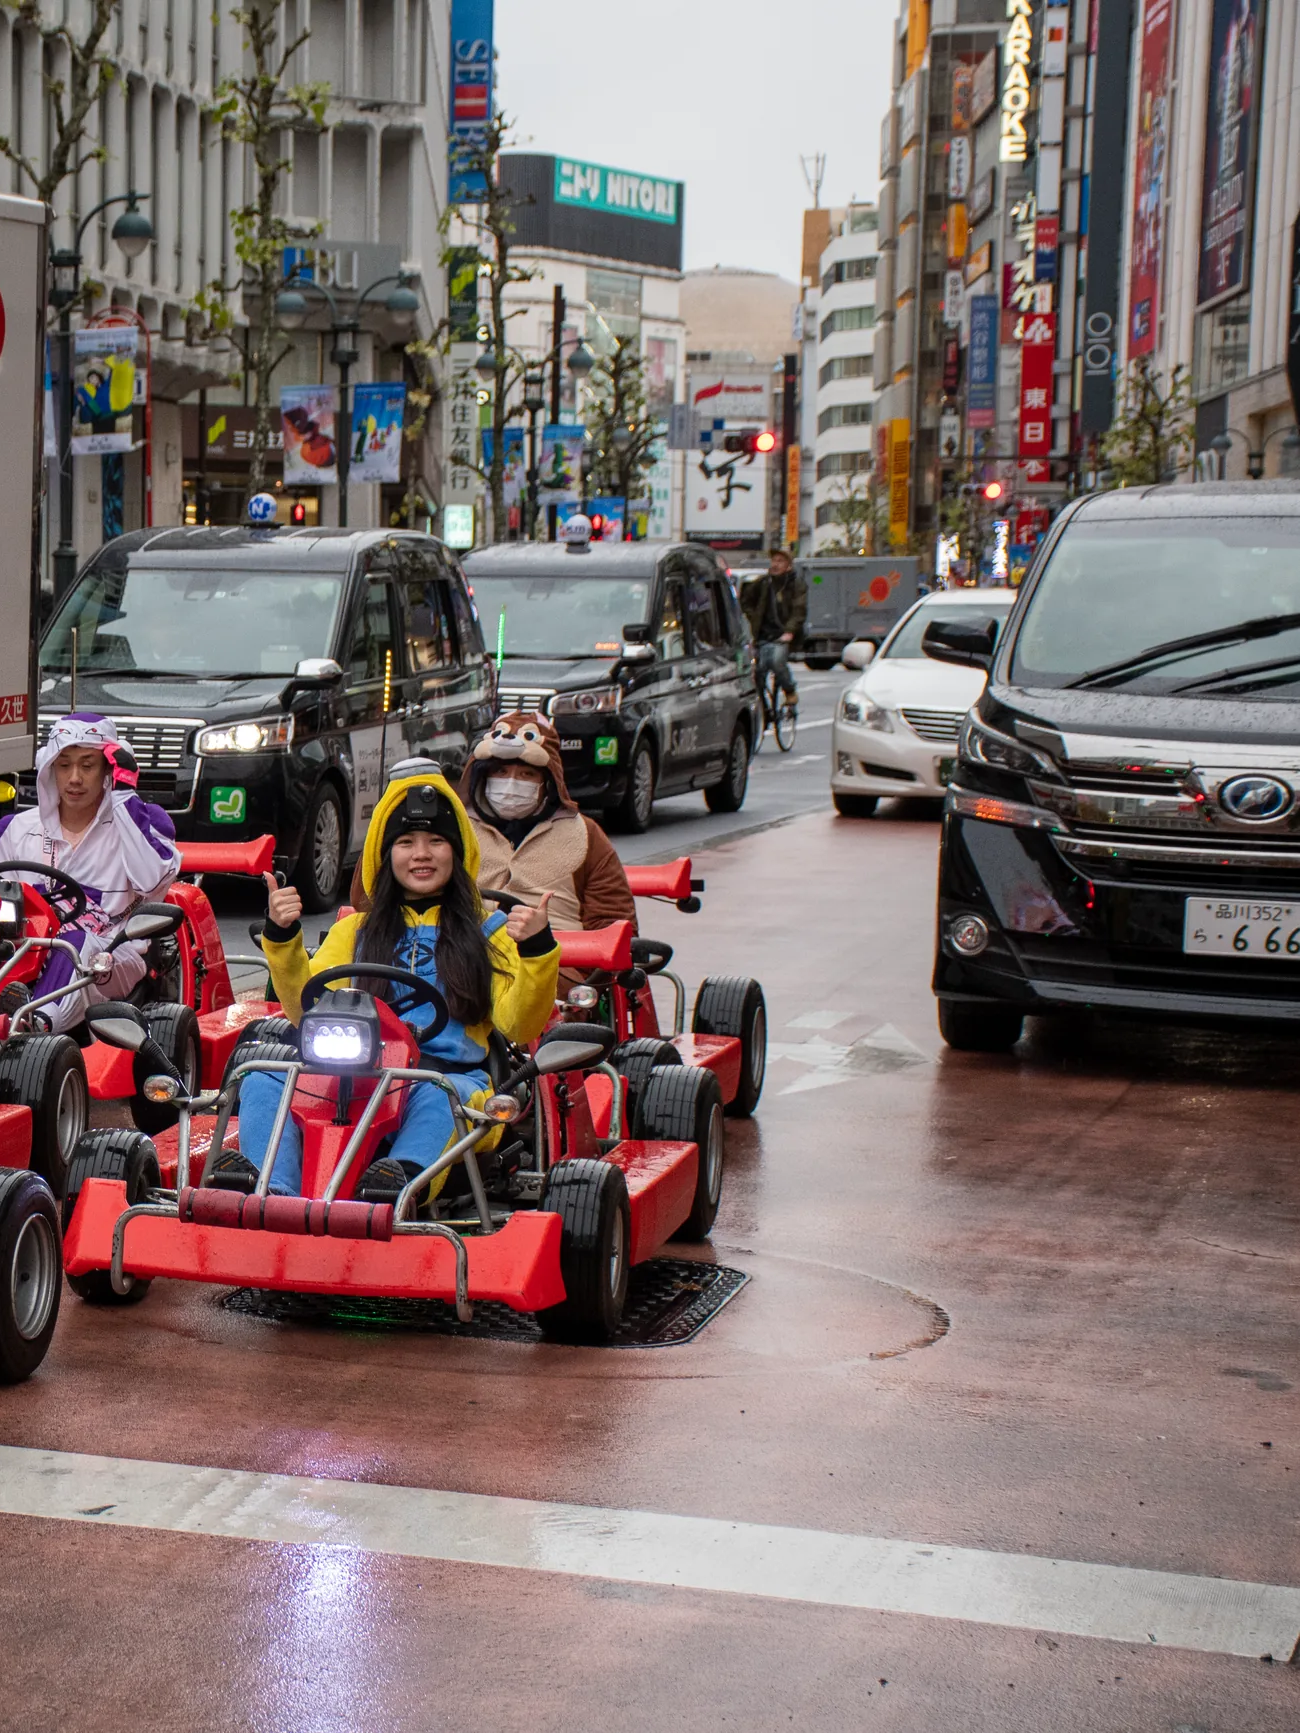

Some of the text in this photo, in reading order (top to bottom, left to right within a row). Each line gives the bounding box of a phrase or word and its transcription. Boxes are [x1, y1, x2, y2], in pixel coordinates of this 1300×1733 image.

[999, 0, 1032, 162] KARAOKE
[560, 161, 677, 217] ニトリ NITORI
